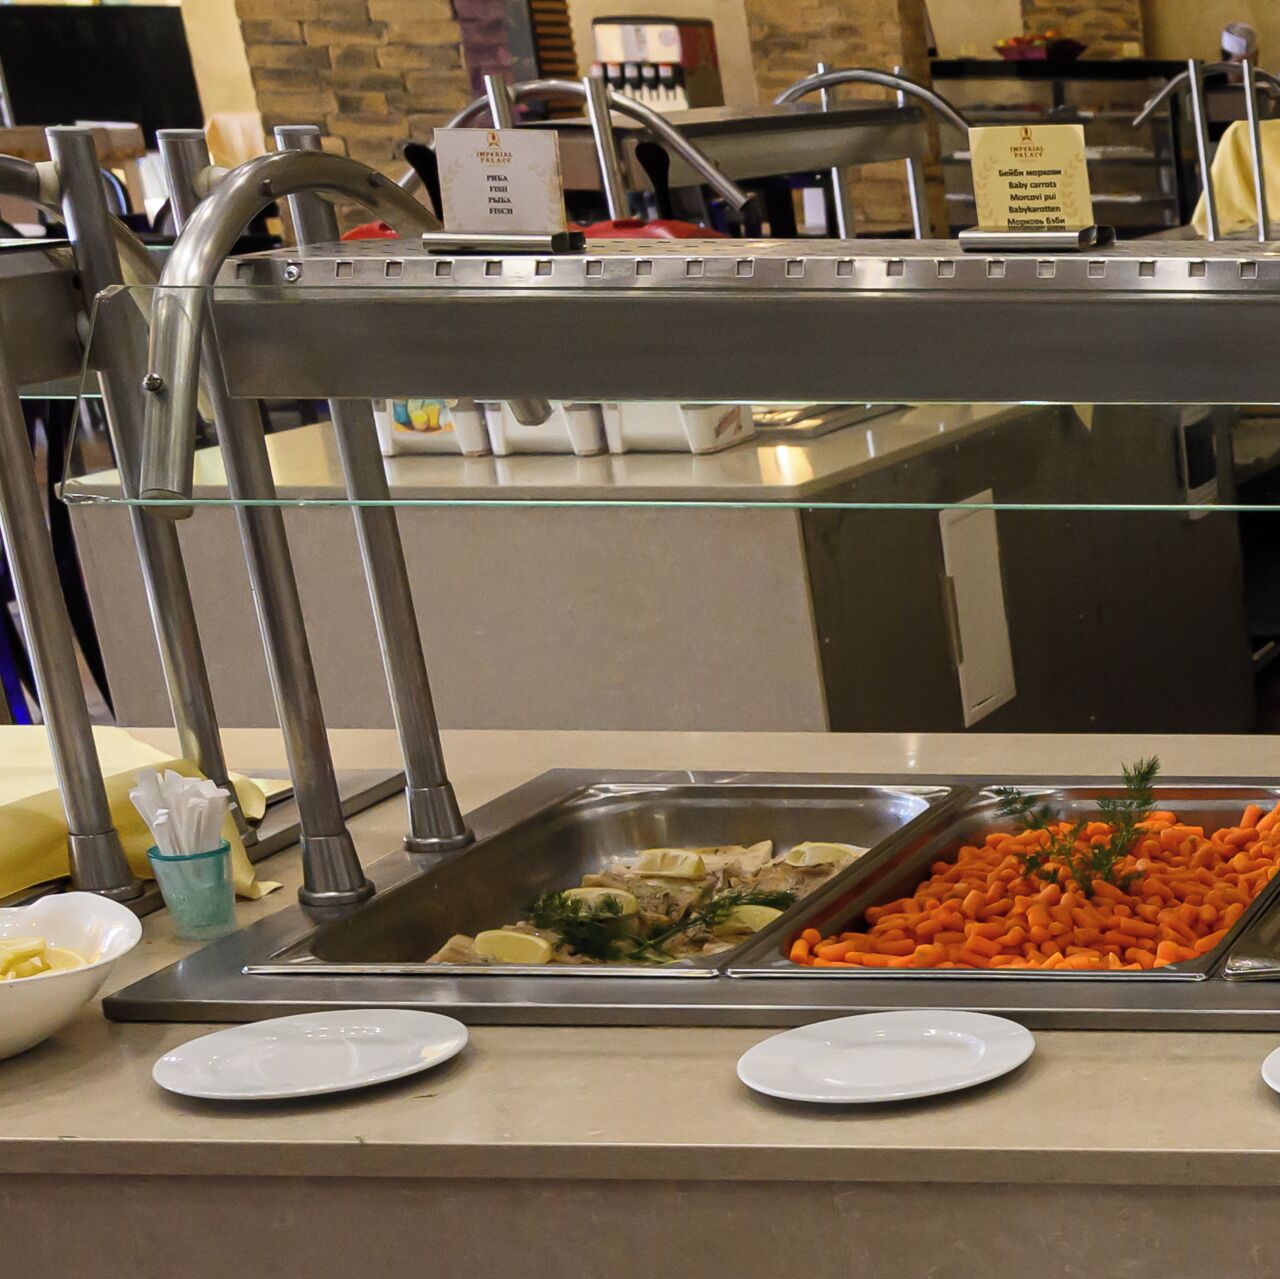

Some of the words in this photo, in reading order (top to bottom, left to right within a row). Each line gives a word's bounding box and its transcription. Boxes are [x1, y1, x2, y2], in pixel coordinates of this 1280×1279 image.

[999, 169, 1024, 177] Бейби
[1026, 169, 1061, 177] моркови
[1009, 181, 1027, 190] Baby
[1010, 193, 1042, 201] Morcovi
[1044, 193, 1056, 201] pui
[1008, 205, 1061, 214] Babykarotten
[1007, 218, 1044, 226] Морковь
